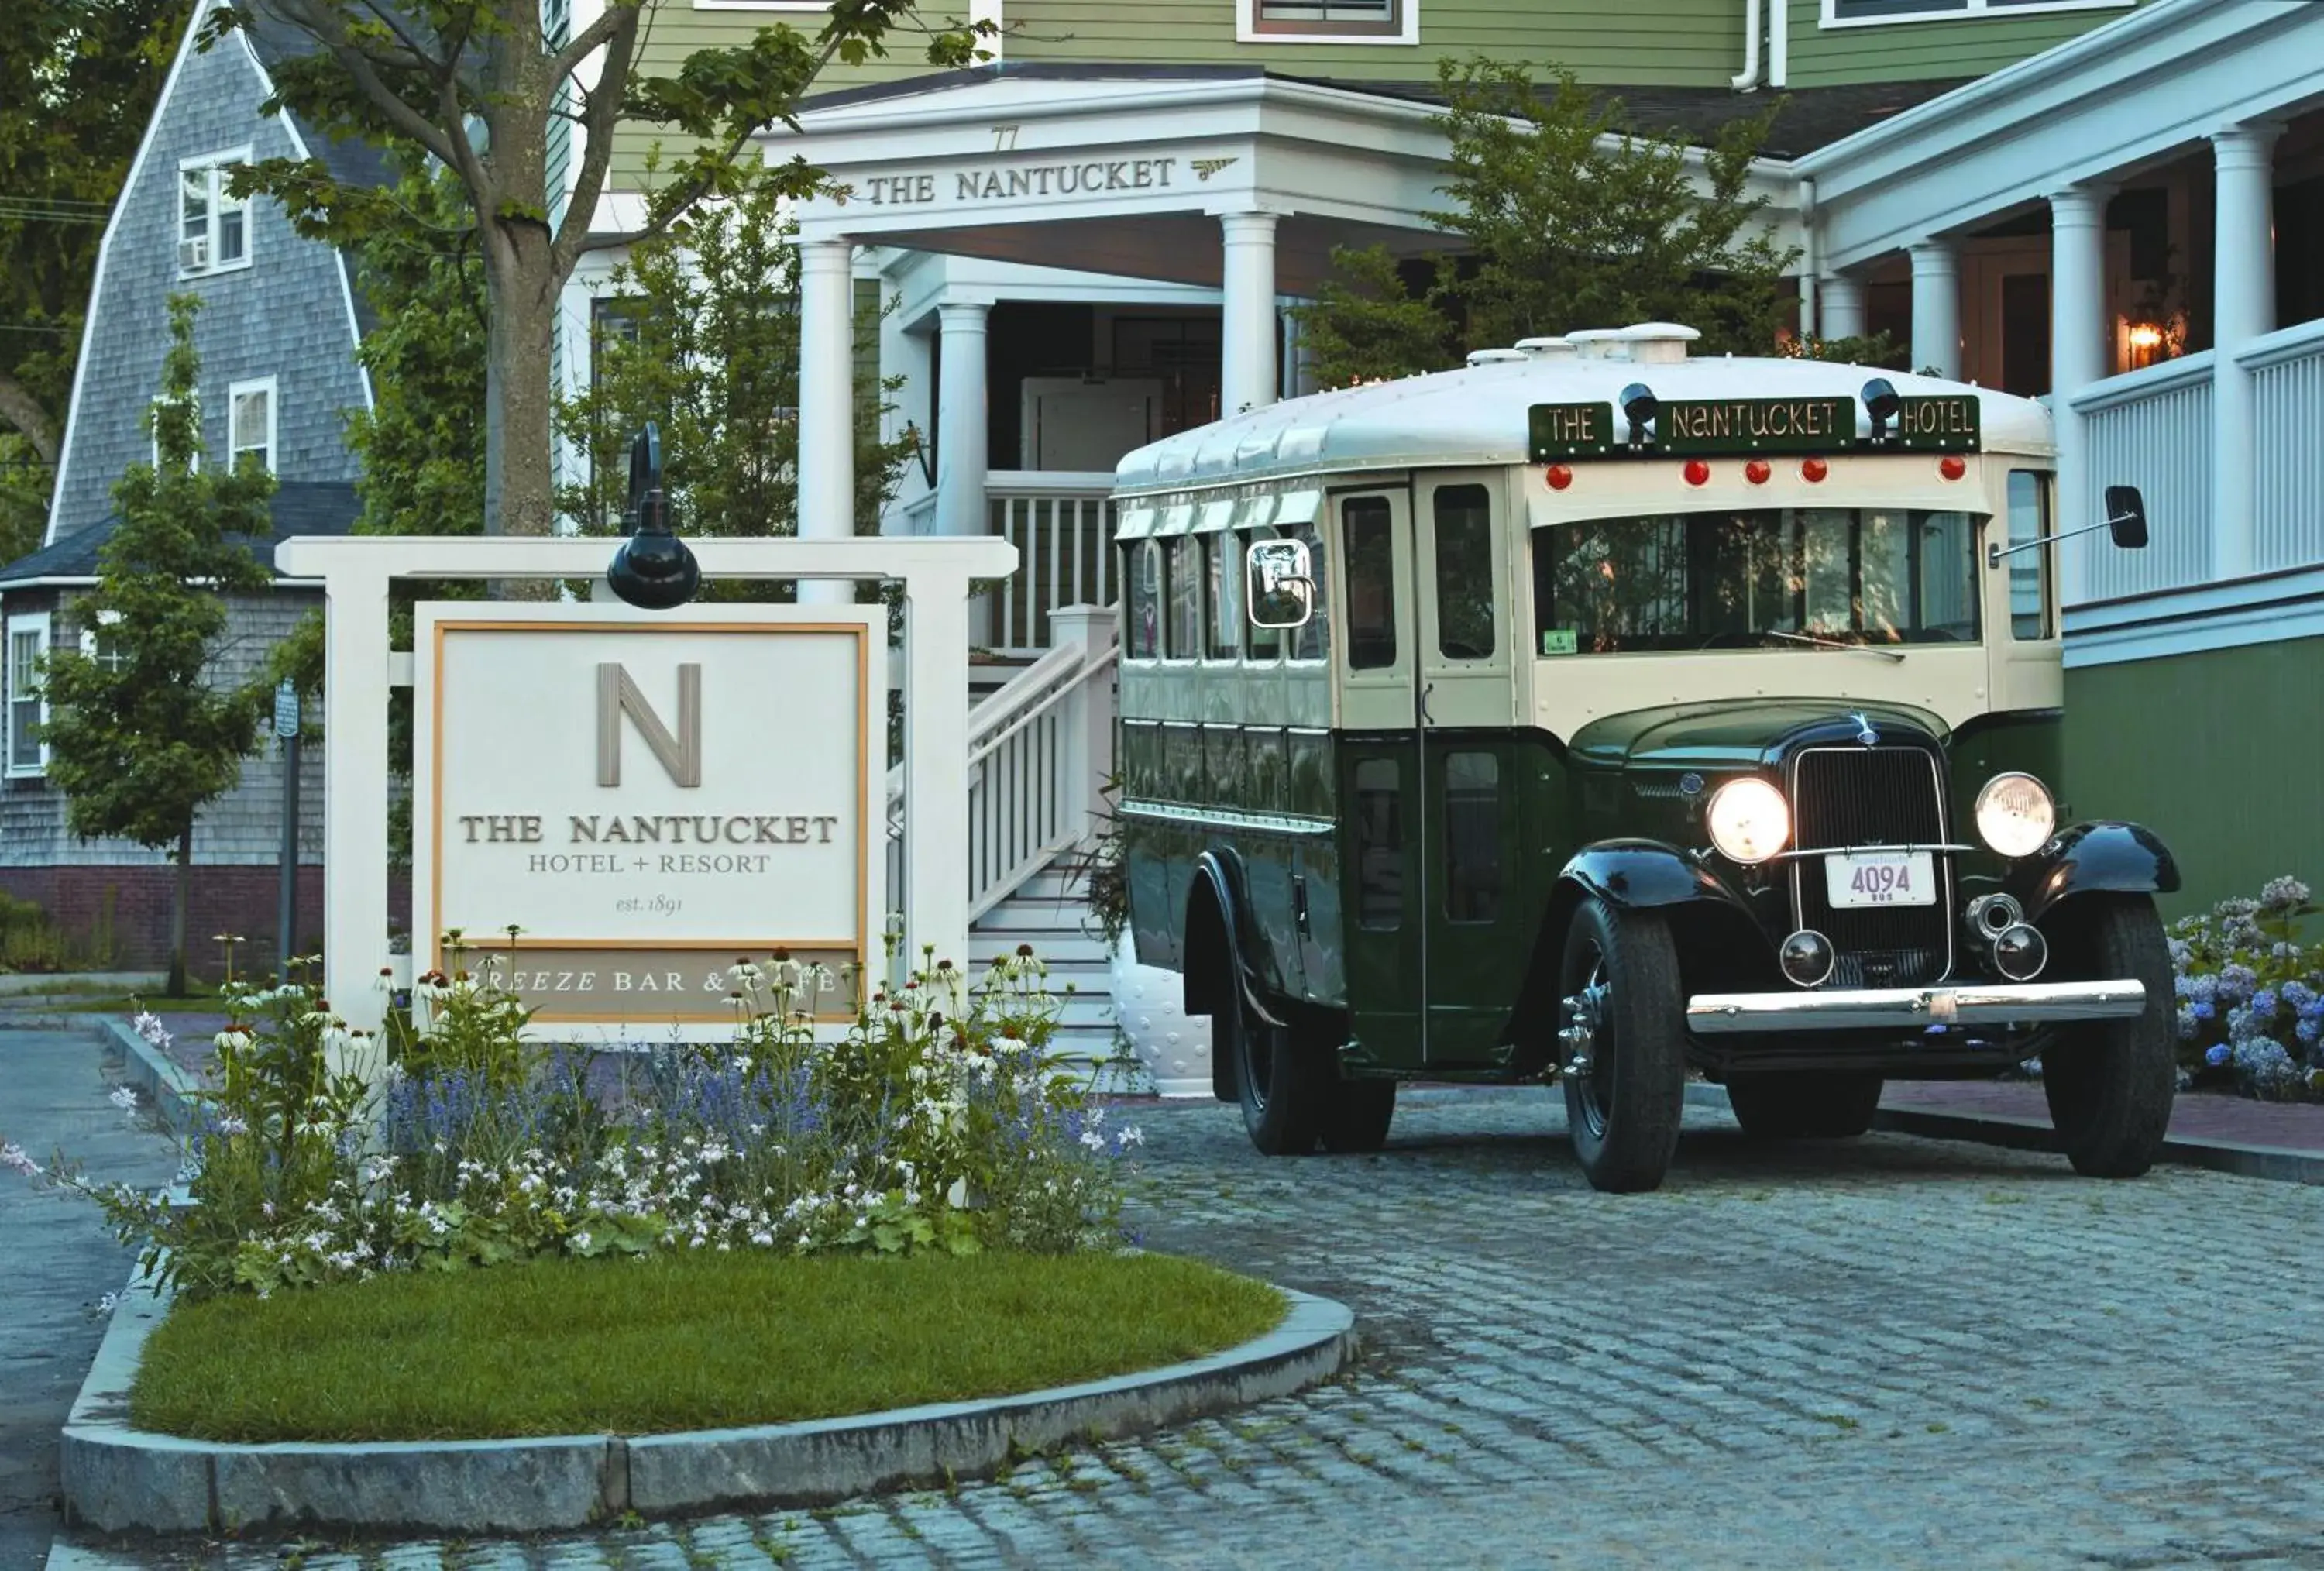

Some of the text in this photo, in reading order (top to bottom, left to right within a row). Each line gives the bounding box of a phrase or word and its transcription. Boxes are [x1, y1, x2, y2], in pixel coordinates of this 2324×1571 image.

[991, 125, 1020, 151] 77
[867, 158, 1177, 205] THE NANTUCKET
[1549, 407, 1594, 442] THE
[1903, 400, 1975, 435] HOTEL
[597, 662, 701, 788] N
[459, 816, 837, 844] THE NANTUCKET
[528, 854, 624, 873] HOTEL
[658, 854, 770, 874] RESORT
[1851, 865, 1910, 892] 4094
[616, 893, 682, 917] est. 1891
[614, 971, 685, 992] BAR
[703, 972, 726, 992] &
